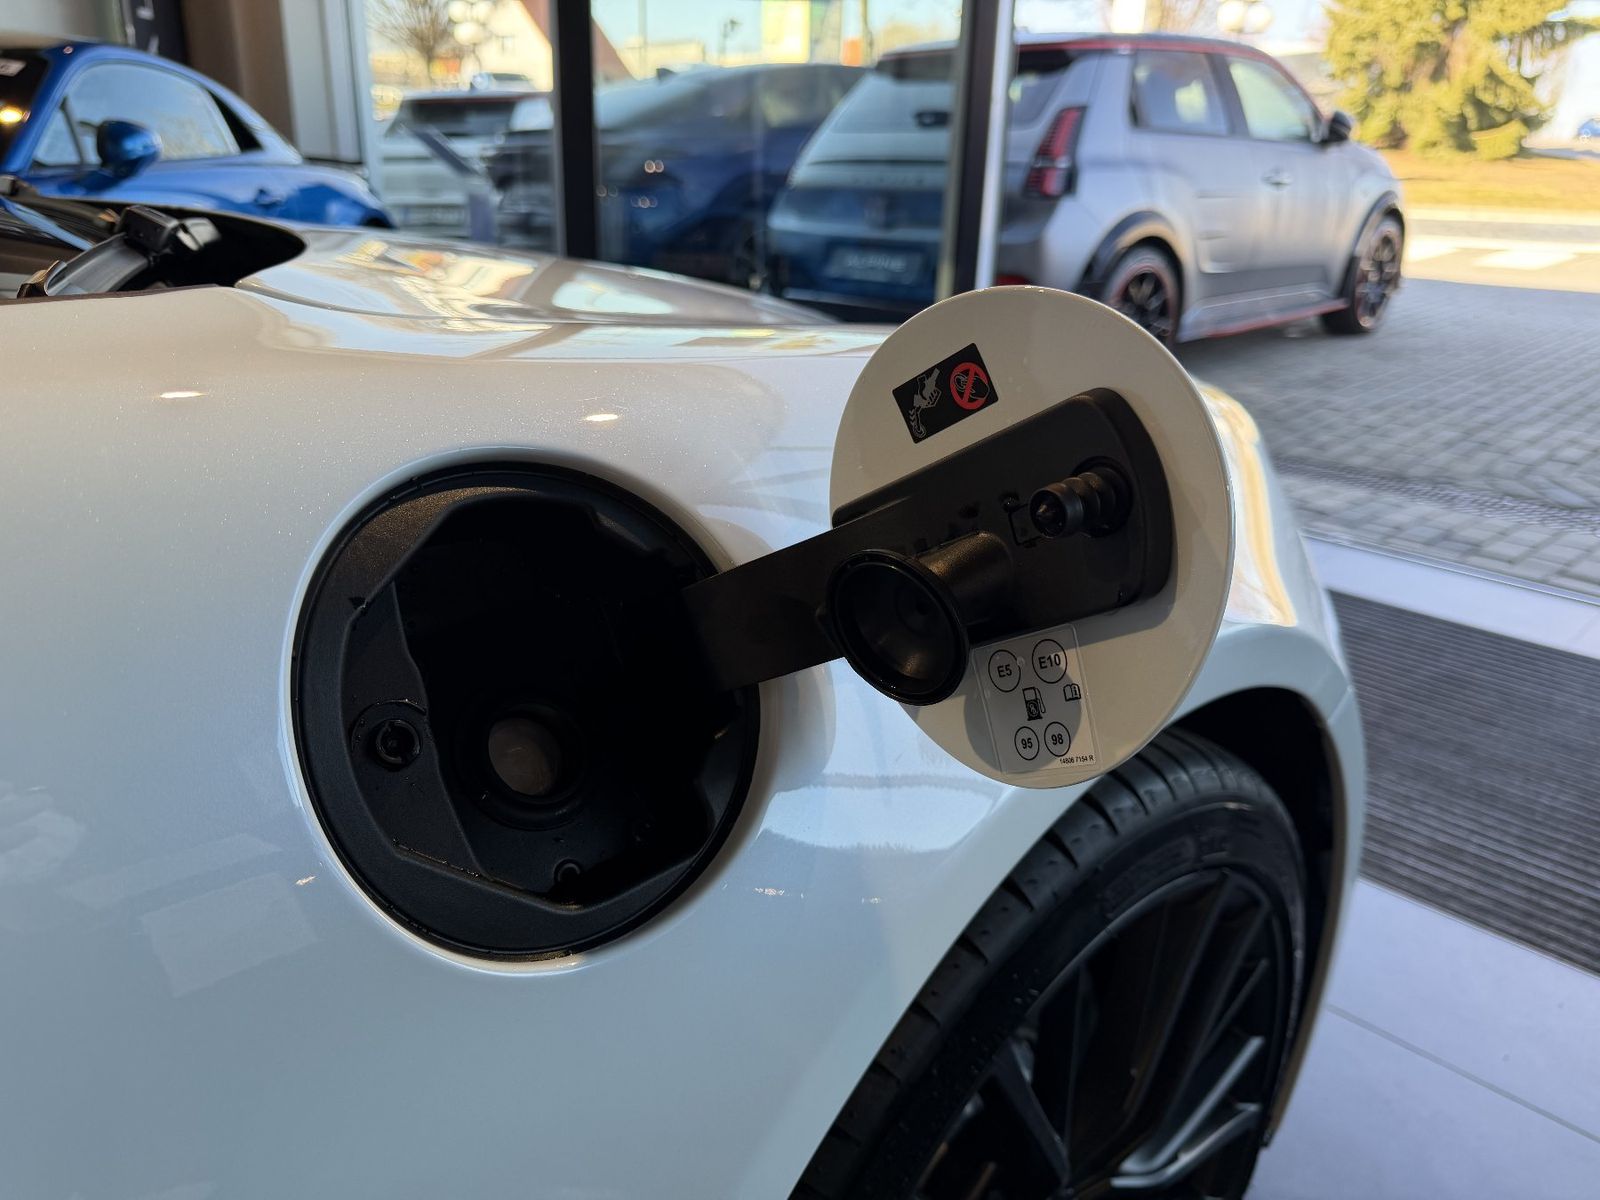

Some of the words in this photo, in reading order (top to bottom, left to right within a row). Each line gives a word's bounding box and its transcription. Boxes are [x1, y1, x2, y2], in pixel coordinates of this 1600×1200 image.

[997, 664, 1012, 677] E5
[1038, 654, 1061, 669] E10
[1021, 738, 1033, 749] 95
[1051, 733, 1064, 745] 98
